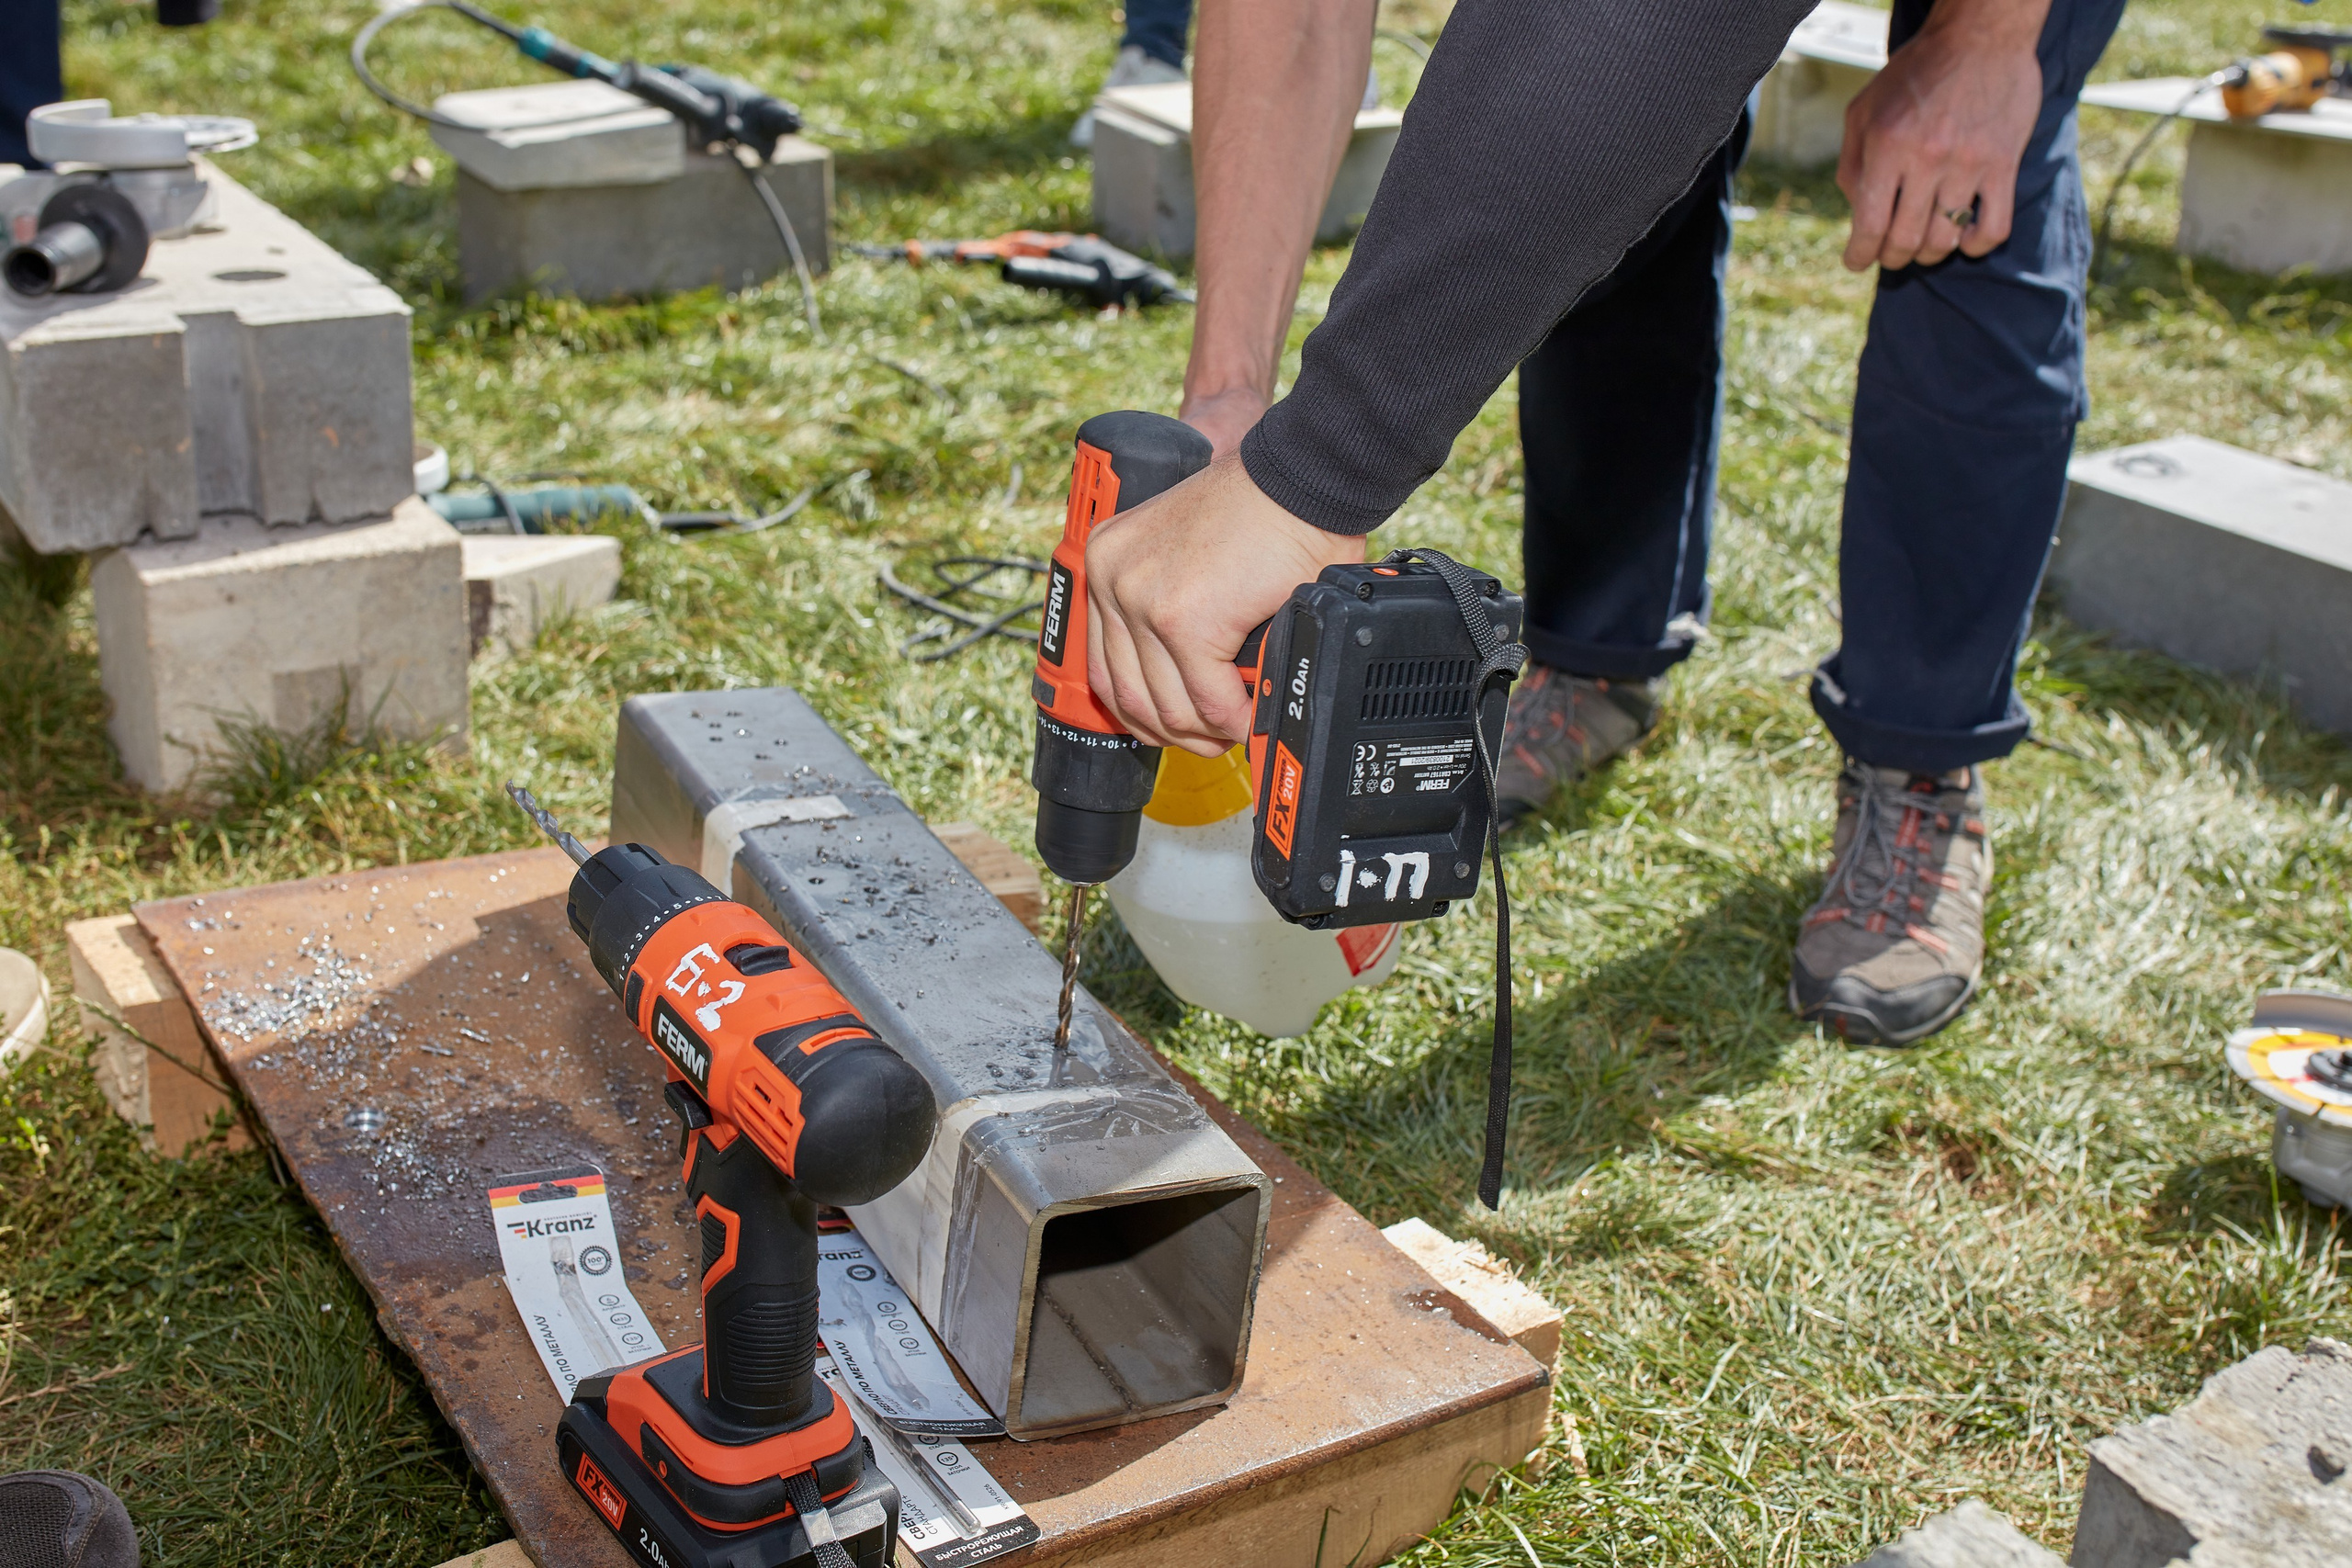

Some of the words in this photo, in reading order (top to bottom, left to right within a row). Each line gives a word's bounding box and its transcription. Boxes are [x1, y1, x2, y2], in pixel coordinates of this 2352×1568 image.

[1044, 570, 1066, 653] FERM
[1288, 657, 1310, 721] 2.0Ah
[1283, 765, 1295, 801] 20V
[1419, 778, 1451, 791] FERM
[1272, 792, 1290, 841] FX
[657, 1012, 707, 1082] FERM
[526, 1217, 595, 1237] Kranz
[818, 1250, 864, 1260] ranz
[533, 1314, 563, 1357] МЕТАЛЛУ
[556, 1359, 571, 1372] ПО
[833, 1339, 865, 1380] МЕТАЛЛУ
[858, 1381, 875, 1393] ПО
[583, 1464, 605, 1498] FX
[604, 1483, 620, 1506] POWER
[602, 1491, 618, 1517] 20V
[934, 1525, 1024, 1562] БЫСТРОРЕЖУЩАЯ
[970, 1543, 1003, 1559] СТАЛЬ
